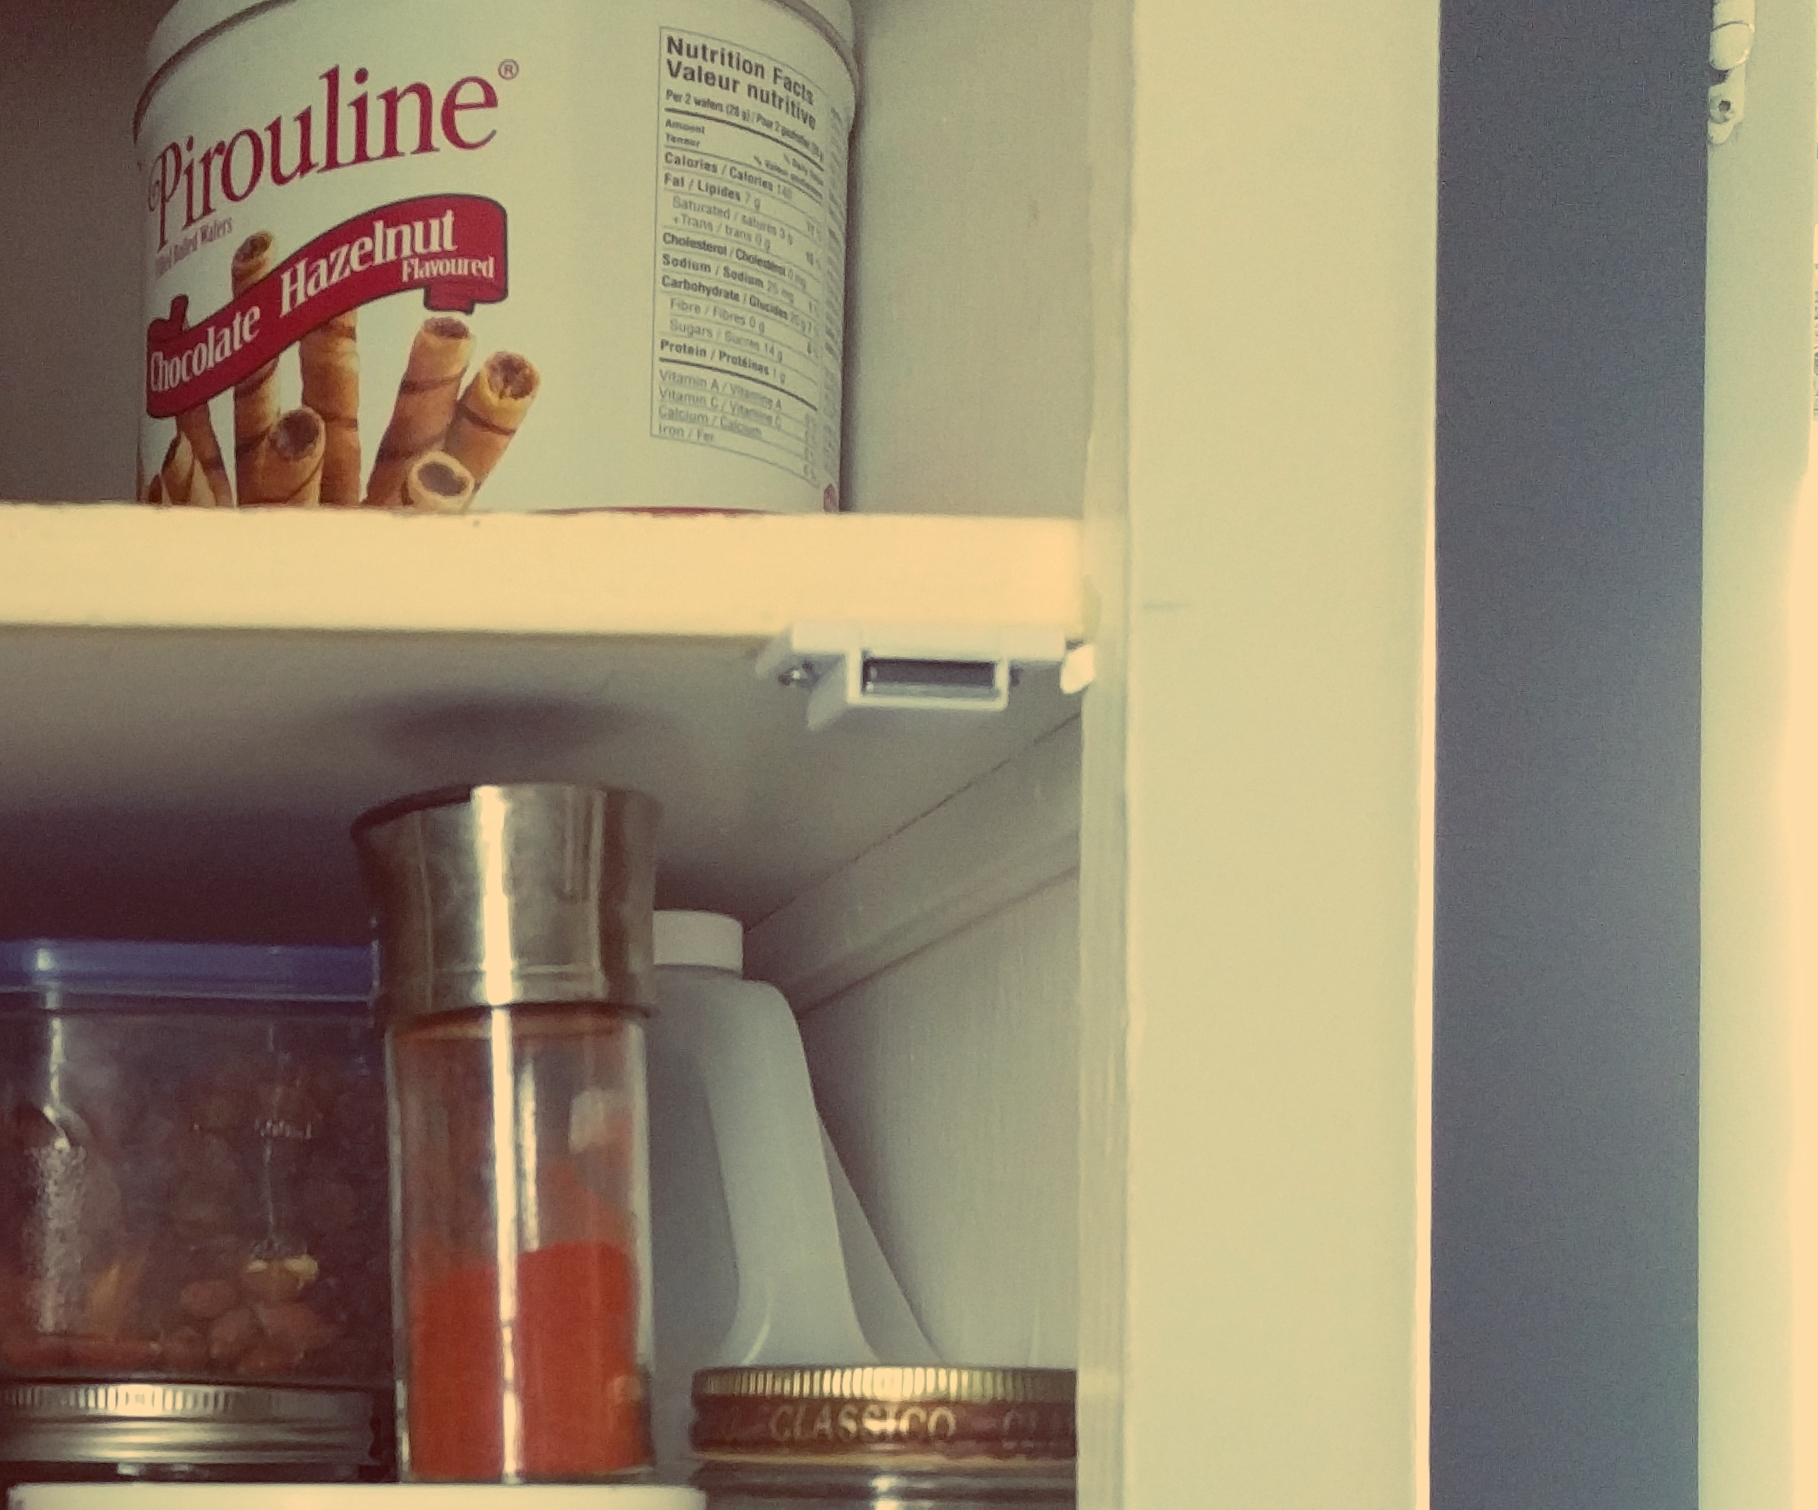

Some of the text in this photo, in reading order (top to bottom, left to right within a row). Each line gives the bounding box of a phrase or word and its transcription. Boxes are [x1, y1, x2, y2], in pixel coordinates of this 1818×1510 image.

[667, 35, 814, 106] Nutrition Facts
[666, 89, 683, 103] Per
[694, 95, 724, 114] wafers
[667, 58, 816, 131] Valeur nutritive
[664, 151, 718, 174] Calories
[729, 166, 773, 192] Calories
[664, 172, 685, 188] Fat
[697, 180, 741, 203] Lipides
[673, 195, 730, 221] Saturated
[662, 231, 727, 256] Cholesterol
[402, 256, 495, 283] Flavoured
[662, 253, 712, 274] Sodium
[723, 266, 764, 288] Sodium
[150, 209, 459, 394] Chocolate Hazelnut
[661, 275, 740, 303] Carbohydrate
[670, 298, 701, 315] Fibre
[712, 305, 746, 326] Fibres
[669, 318, 713, 339] Sugars
[660, 338, 707, 358] Protein
[659, 369, 707, 388] Vitamin
[711, 378, 720, 391] A
[659, 387, 707, 405] Vitamin
[658, 404, 709, 424] Calcium
[659, 422, 684, 437] Iron
[697, 427, 715, 442] Fer
[769, 1404, 957, 1442] CLASSICO
